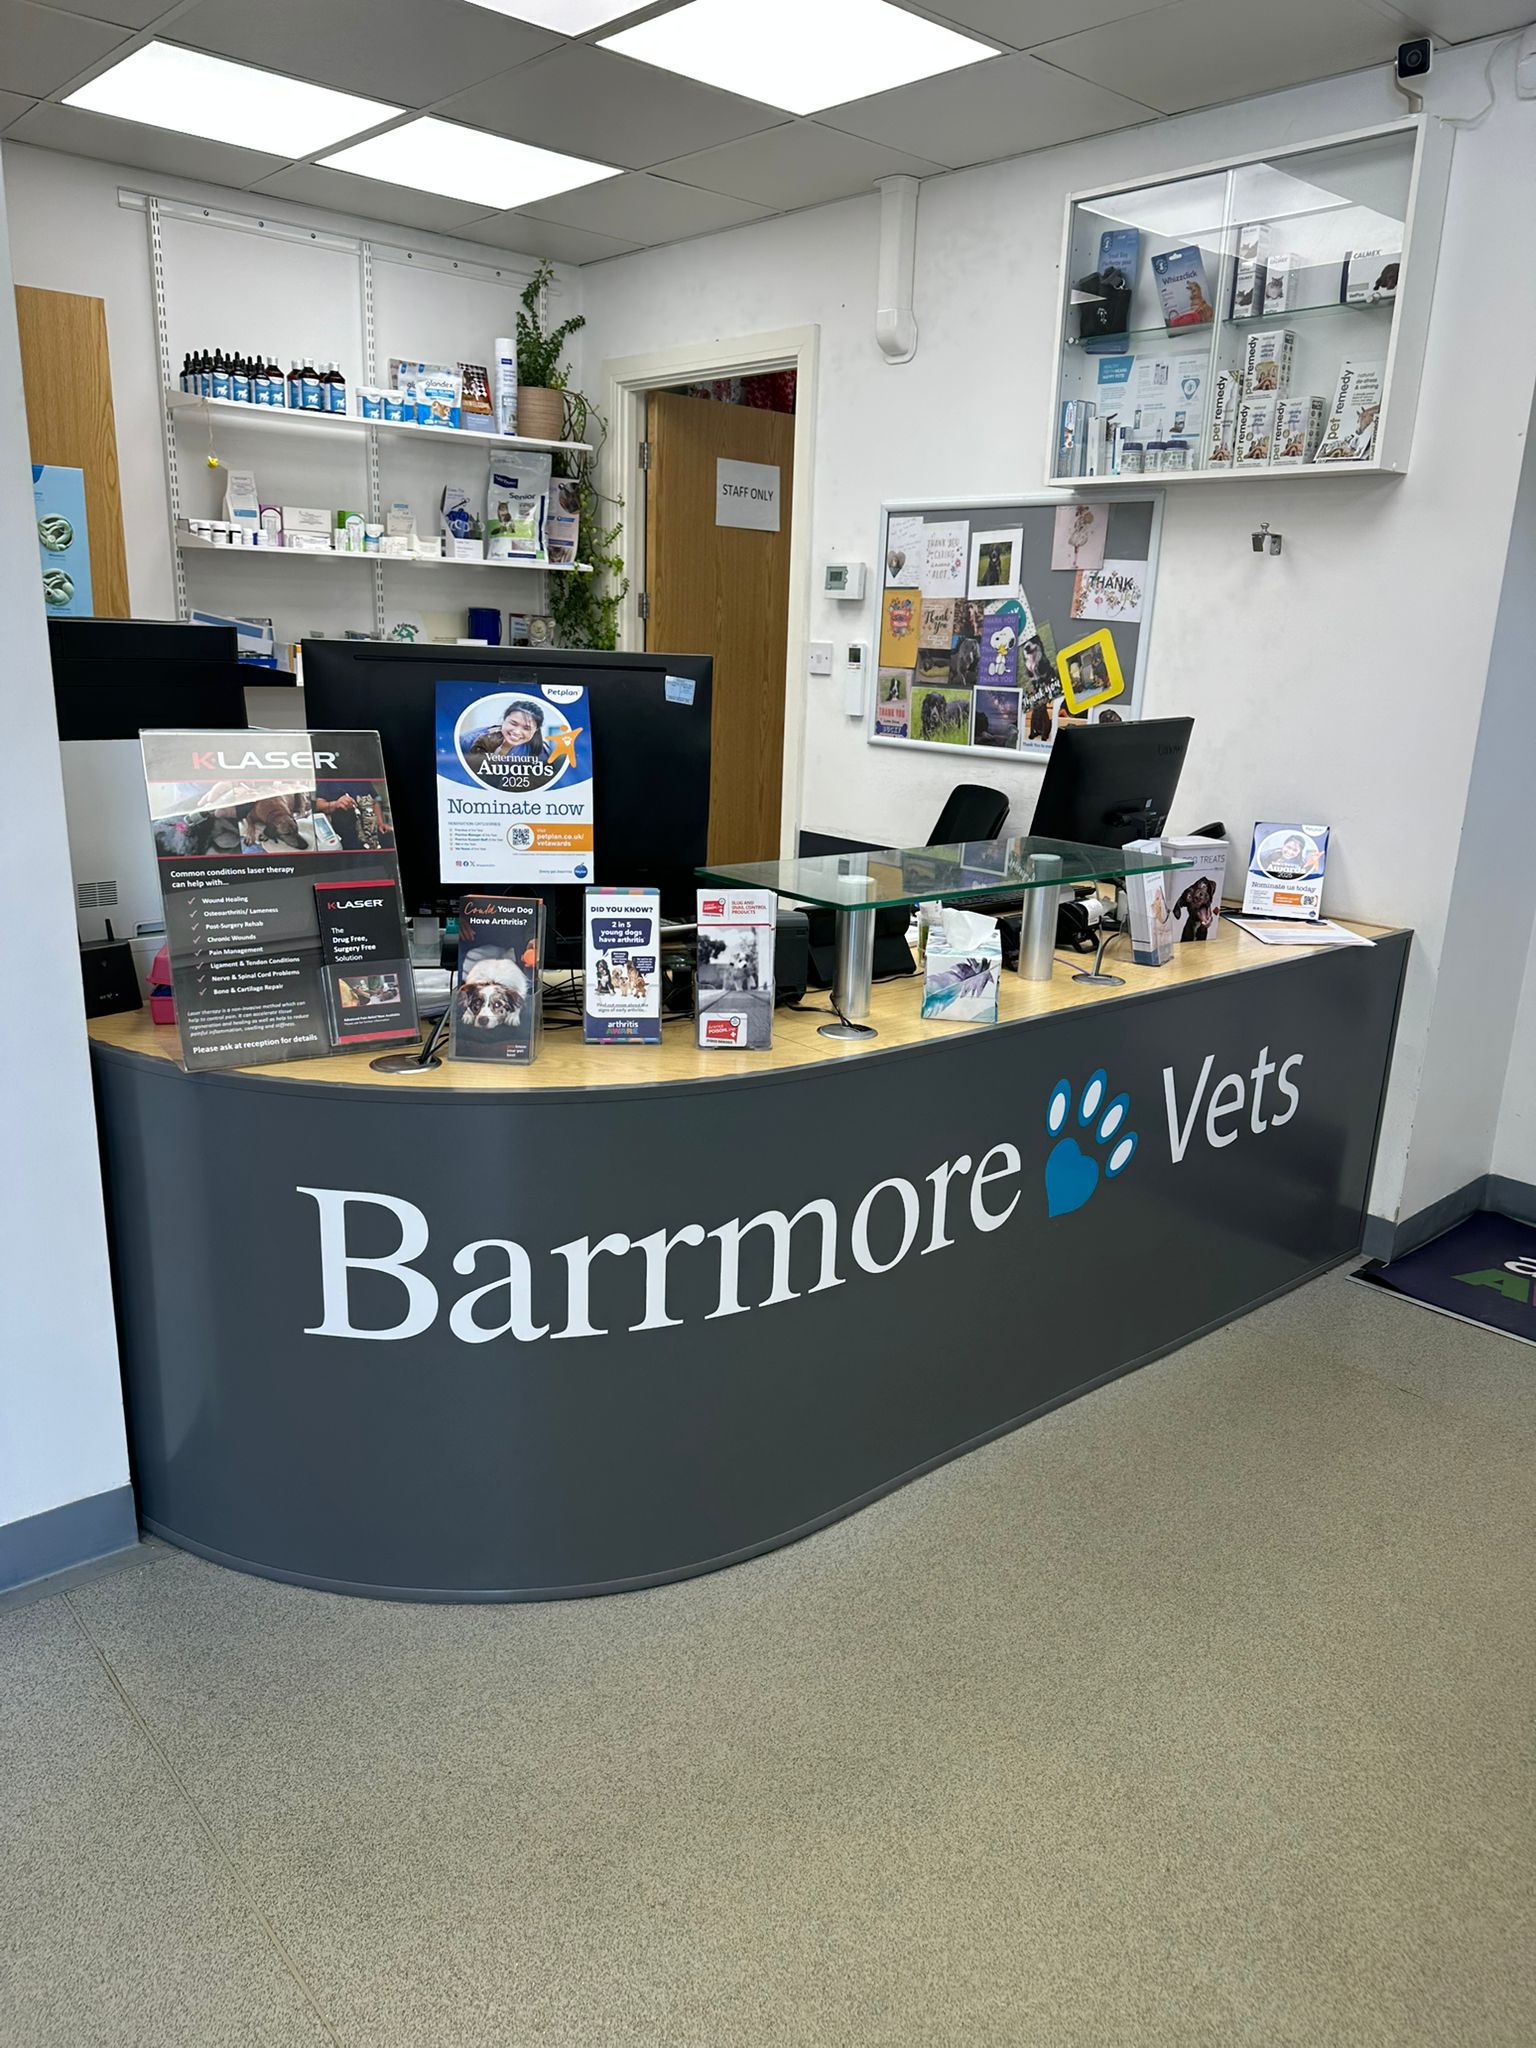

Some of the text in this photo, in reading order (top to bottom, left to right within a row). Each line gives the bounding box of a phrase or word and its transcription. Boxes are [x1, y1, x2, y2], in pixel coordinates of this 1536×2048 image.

[1354, 250, 1382, 258] CALMEX
[1162, 270, 1198, 285] Whizzclick
[1248, 336, 1258, 376] remedy
[425, 379, 452, 388] glandex
[1212, 376, 1228, 442] pet remedy
[1327, 370, 1354, 440] pet remedy
[1238, 405, 1250, 444] remedy
[1276, 402, 1287, 440] remedy
[509, 492, 536, 500] Senior
[722, 484, 774, 502] STAFF ONLY
[1090, 576, 1134, 592] THANK
[925, 608, 948, 624] Thank
[934, 621, 948, 635] You
[548, 688, 578, 697] Petplan
[879, 707, 905, 718] THANK YOU
[485, 752, 538, 764] Veterinary
[477, 761, 554, 776] Awards
[502, 776, 530, 788] 2025
[448, 798, 584, 816] Nominate now
[537, 833, 584, 841] petplan.co.uk/
[1200, 855, 1225, 863] TREATS
[170, 870, 205, 878] Common
[206, 868, 246, 876] conditions
[266, 866, 295, 874] therapy
[1266, 864, 1306, 873] Awards
[187, 880, 204, 888] help
[1251, 881, 1285, 890] Nominate
[1296, 884, 1317, 893] today
[464, 902, 533, 916] Could Your Dog
[206, 922, 243, 930] Post-Surgery
[492, 918, 527, 926] Arthritis?
[601, 929, 642, 938] young dogs
[223, 947, 263, 956] Management
[335, 954, 363, 962] Solution
[238, 972, 256, 980] Spinal
[237, 985, 263, 993] Cartilage
[608, 1020, 638, 1028] arthritis
[193, 1045, 218, 1054] Please
[244, 1039, 280, 1048] reception
[293, 1034, 318, 1043] details
[296, 1046, 1304, 1345] Barrmore Vets
